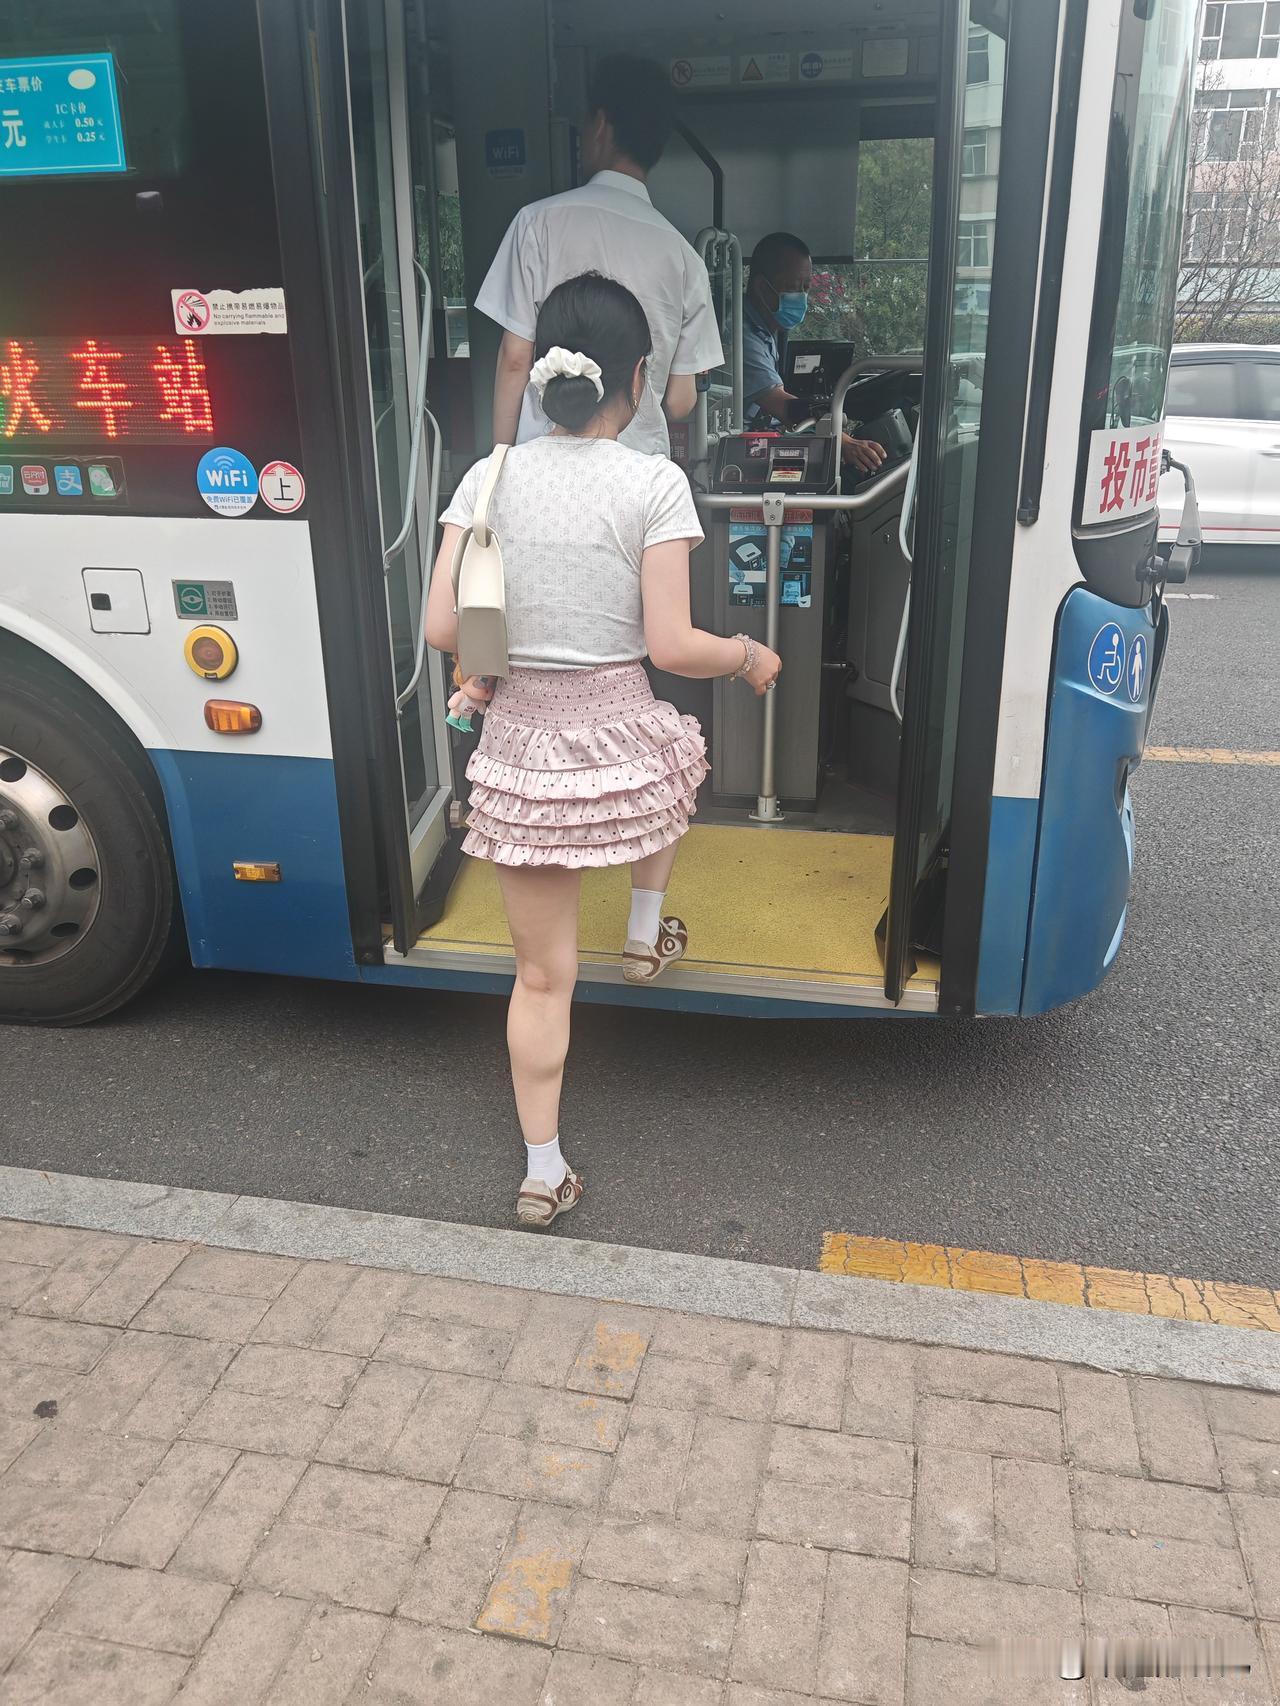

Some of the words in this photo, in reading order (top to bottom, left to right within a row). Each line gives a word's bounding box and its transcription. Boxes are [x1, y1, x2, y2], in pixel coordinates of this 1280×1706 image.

[2, 109, 26, 149] 元
[75, 117, 95, 128] 0.50
[76, 131, 97, 142] 0.25
[1, 339, 213, 438] 火车站
[205, 469, 248, 487] WiFi
[273, 477, 294, 500] 上
